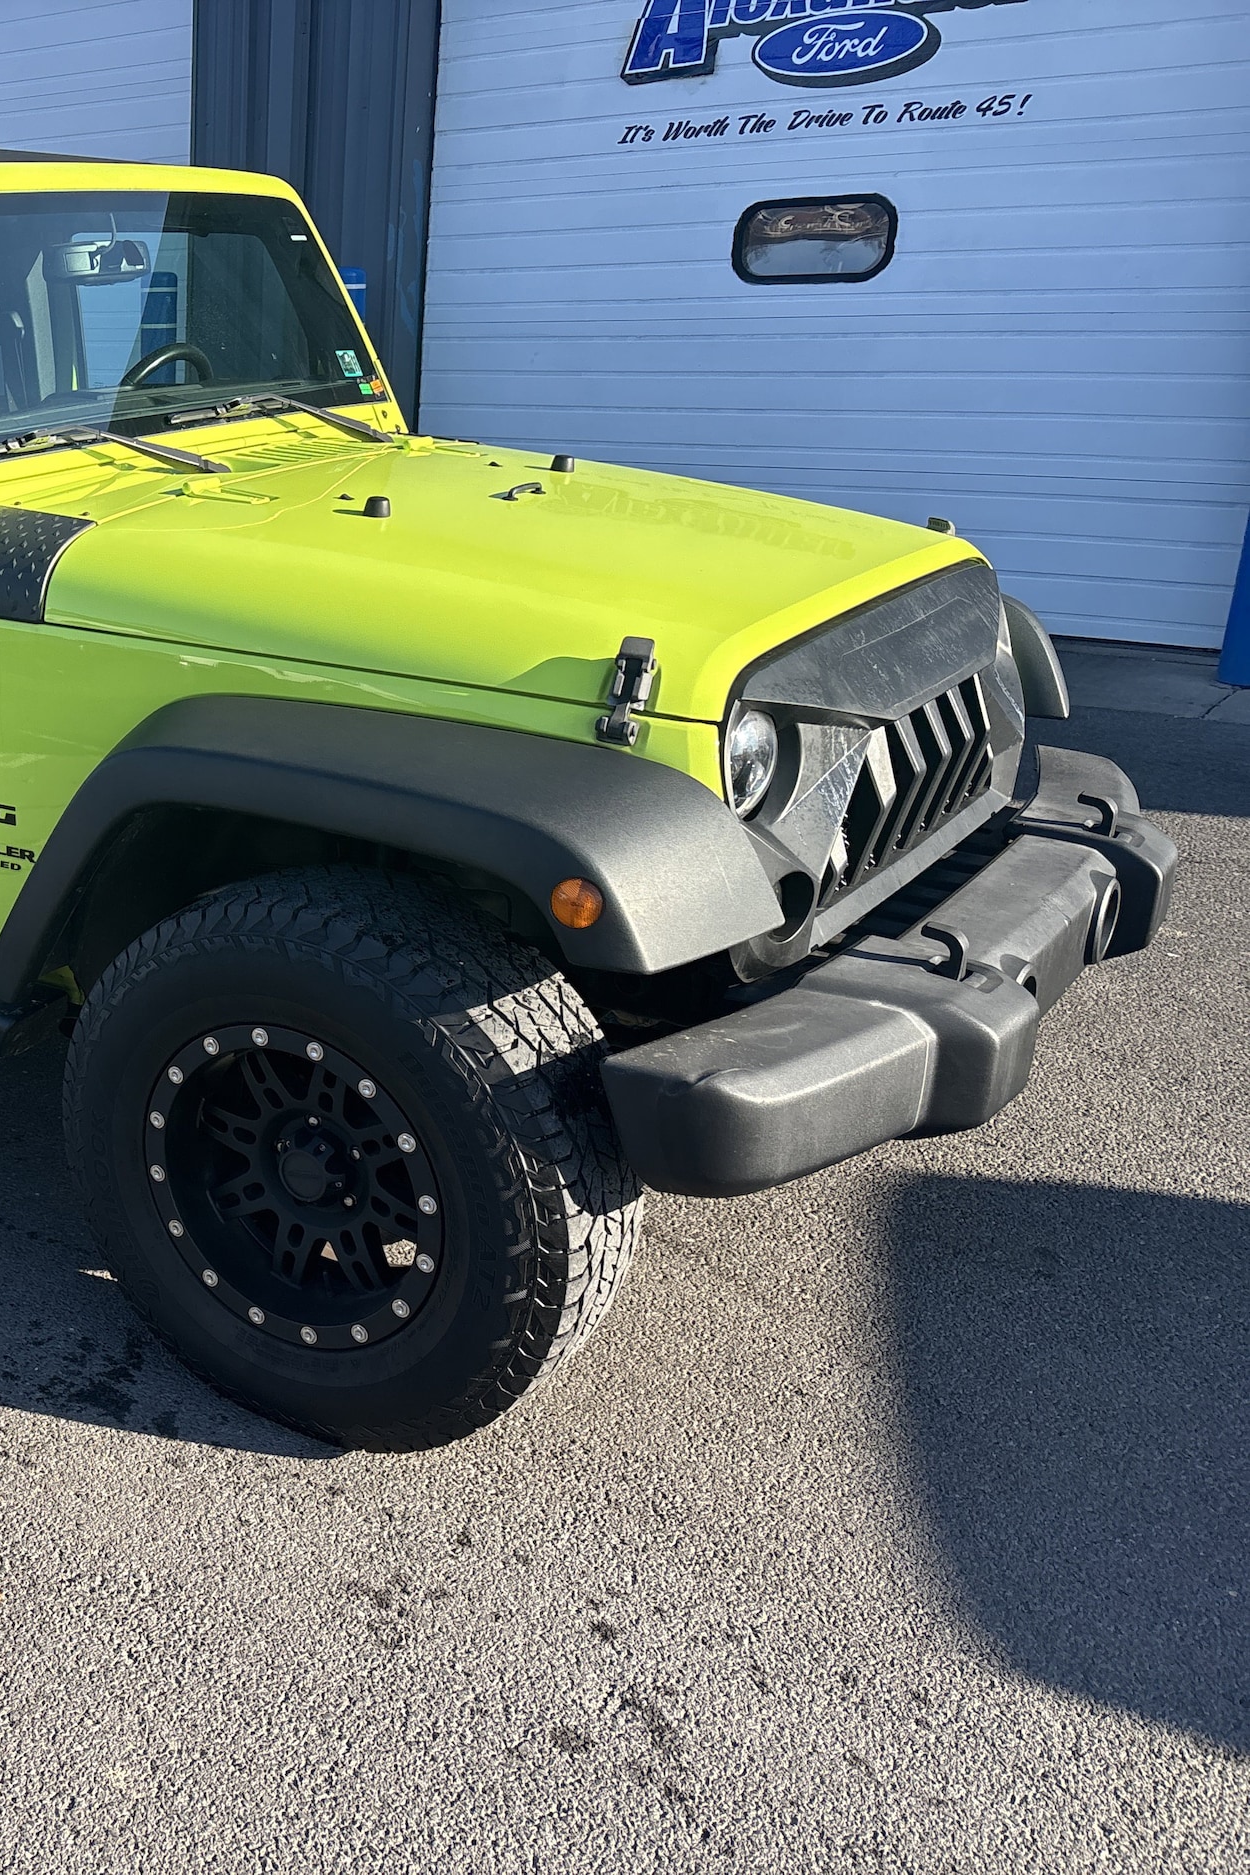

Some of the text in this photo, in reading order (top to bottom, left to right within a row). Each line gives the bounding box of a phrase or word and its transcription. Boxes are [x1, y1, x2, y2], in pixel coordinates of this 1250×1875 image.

[791, 21, 886, 65] Ford
[617, 124, 656, 145] It's
[662, 115, 730, 142] Worth
[738, 112, 777, 136] The
[786, 109, 854, 131] Drive
[861, 103, 889, 126] To
[896, 99, 968, 123] Route
